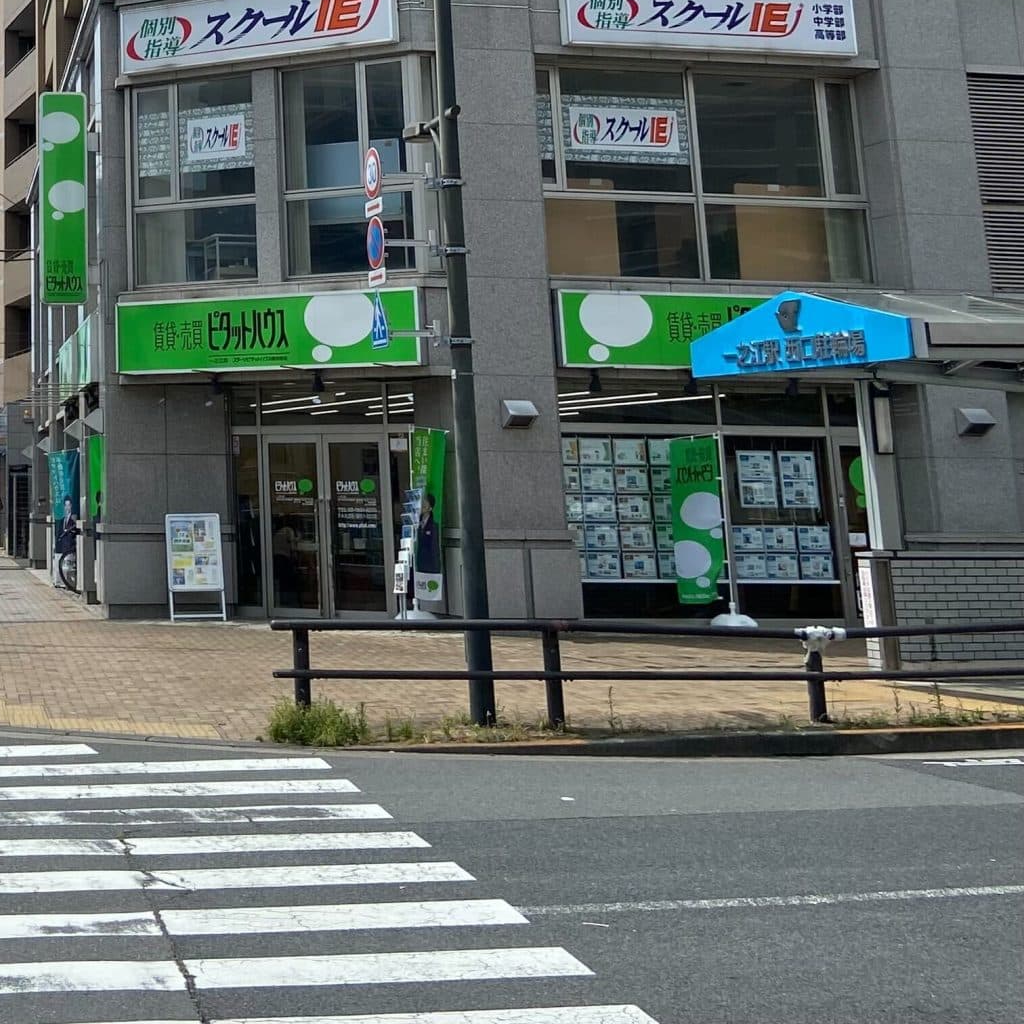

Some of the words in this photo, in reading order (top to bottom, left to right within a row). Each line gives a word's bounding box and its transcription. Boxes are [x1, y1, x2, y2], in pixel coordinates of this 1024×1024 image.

[595, 11, 630, 30] 指導
[639, 0, 791, 34] スクールIE
[812, 4, 844, 15] 小学部
[139, 16, 176, 38] 個別
[813, 17, 845, 28] 中学部
[814, 29, 846, 41] 高等部
[144, 37, 181, 59] 指導
[154, 320, 203, 351] 賃貸・売買
[207, 308, 289, 351] ピタットハウス
